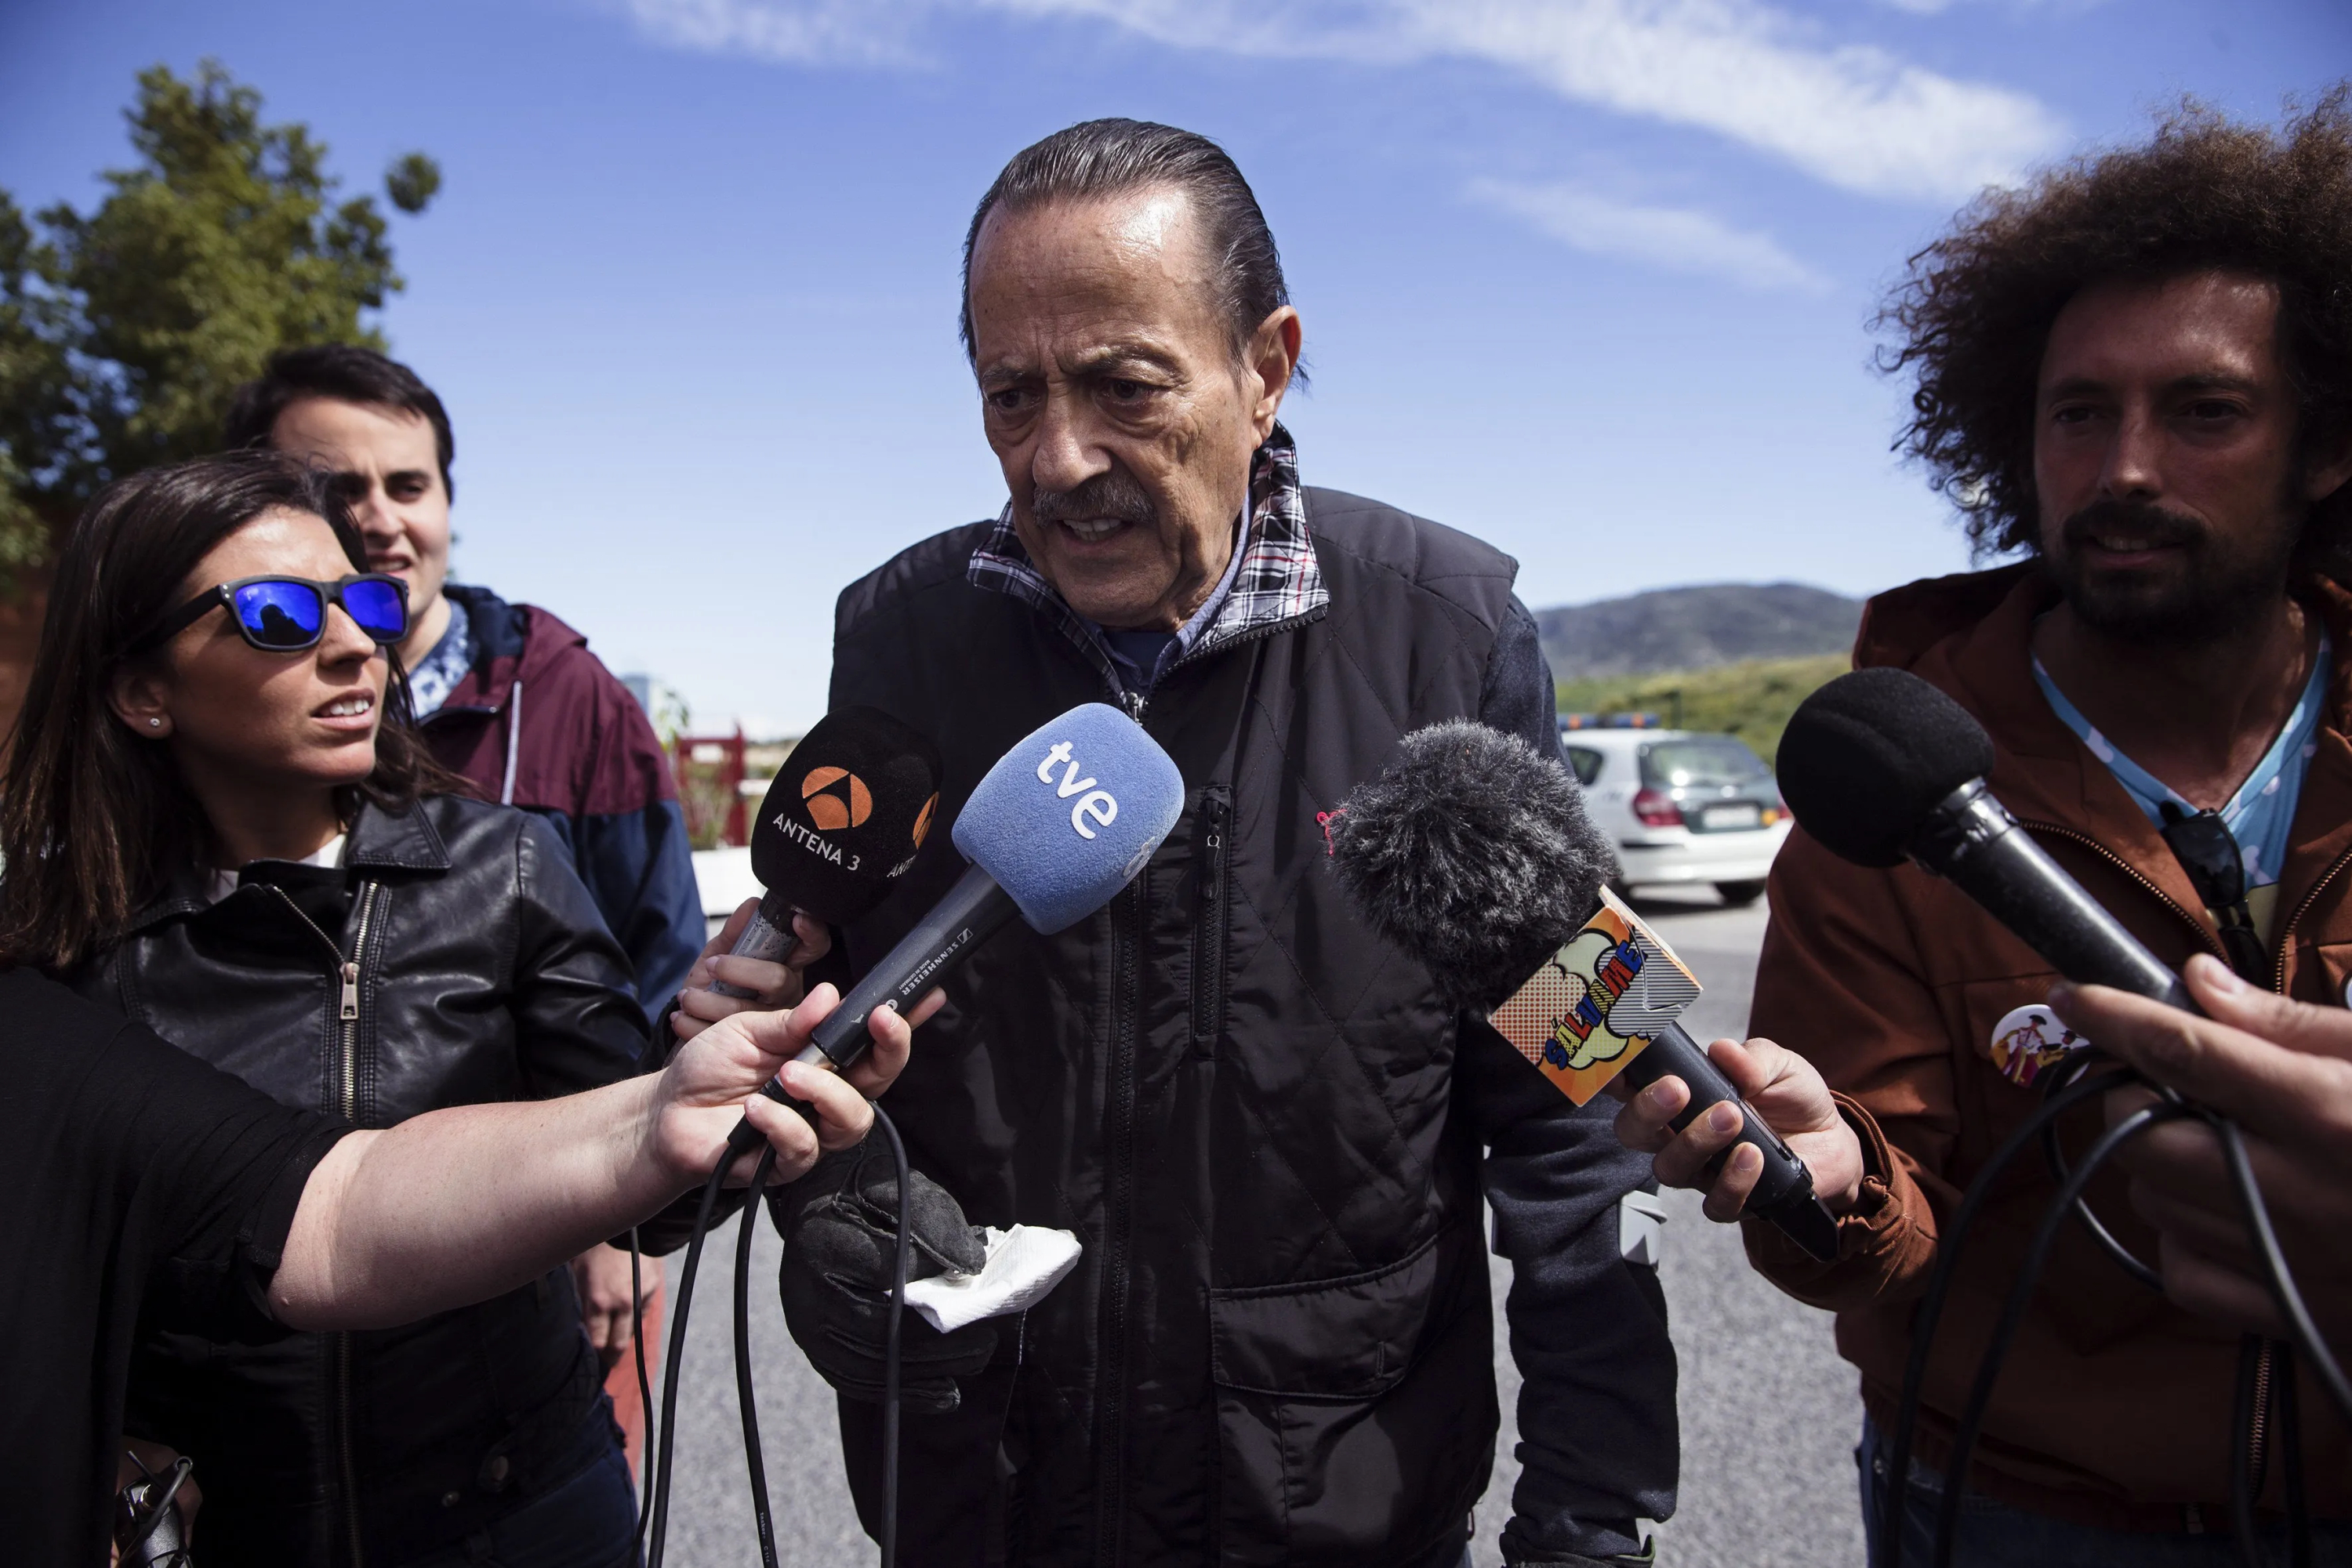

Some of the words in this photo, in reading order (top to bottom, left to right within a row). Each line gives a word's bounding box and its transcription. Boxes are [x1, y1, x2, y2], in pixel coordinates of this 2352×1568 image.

[1036, 741, 1118, 840] tve
[772, 813, 841, 866] ANTENA
[847, 855, 861, 871] 3
[898, 972, 916, 990] GERMANY
[902, 942, 959, 996] SENNHEISER
[919, 959, 931, 971] MADE
[1544, 940, 1643, 1071] SÁLVAME
